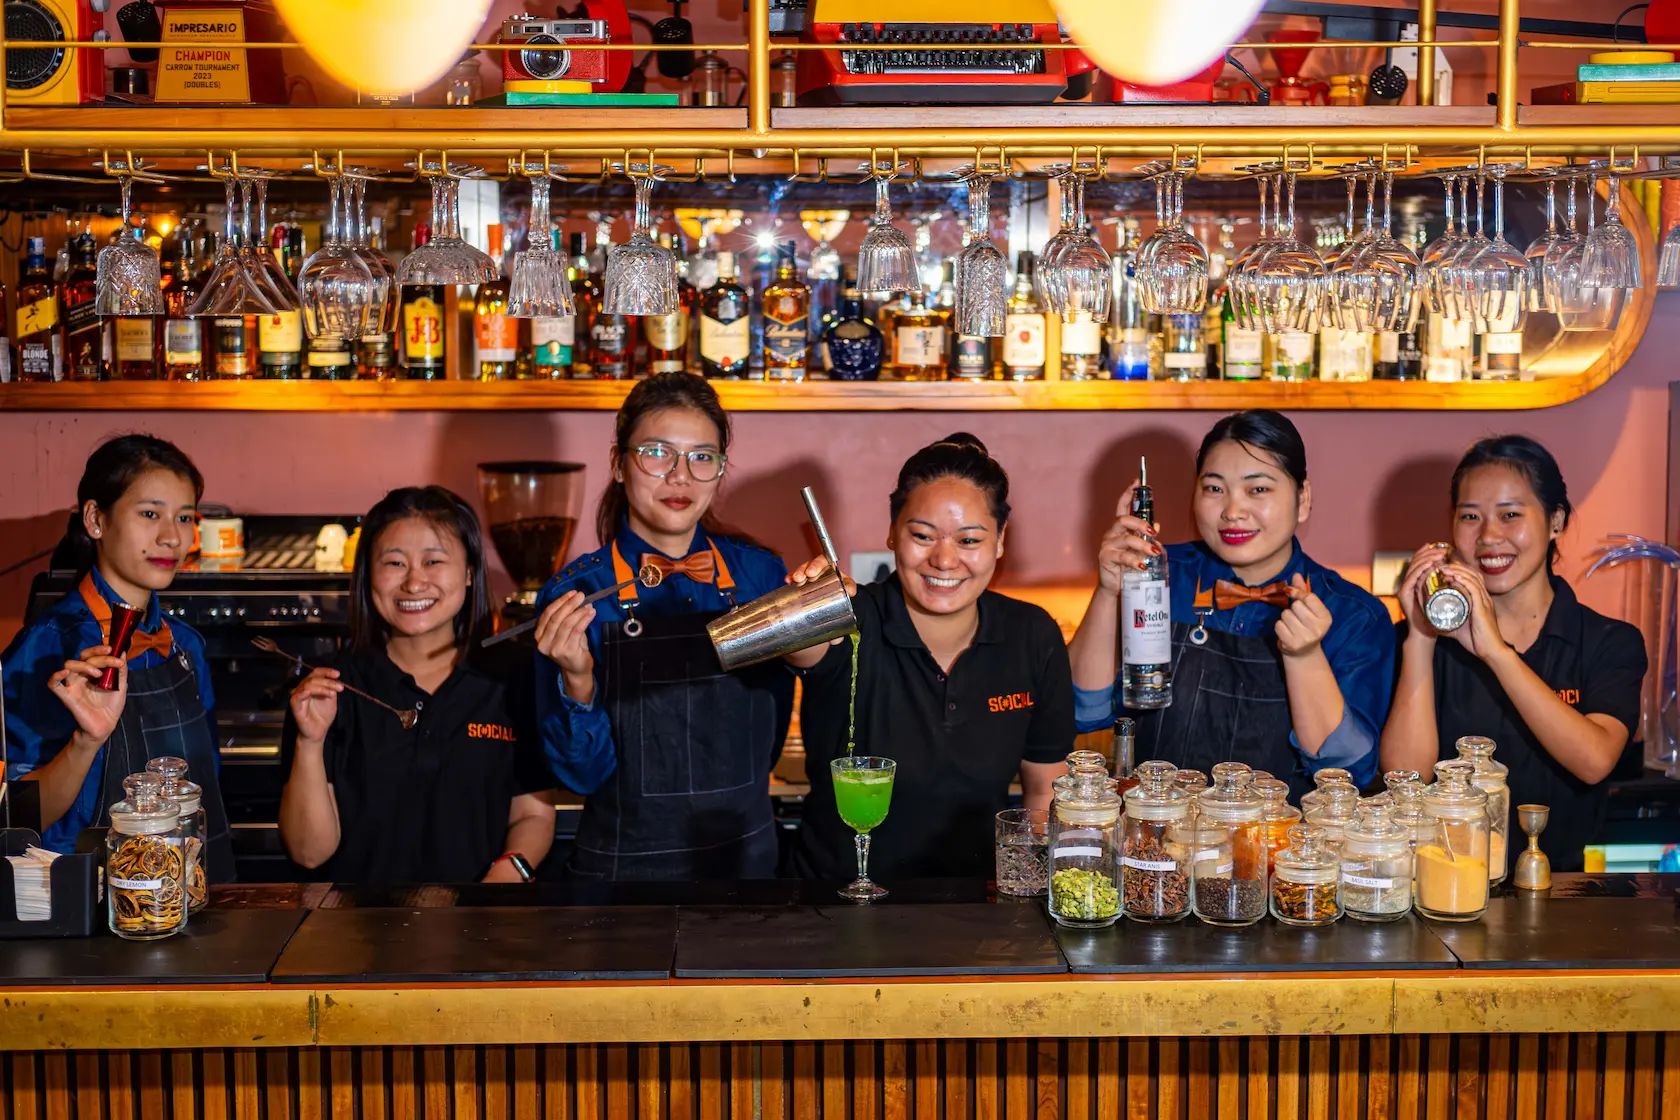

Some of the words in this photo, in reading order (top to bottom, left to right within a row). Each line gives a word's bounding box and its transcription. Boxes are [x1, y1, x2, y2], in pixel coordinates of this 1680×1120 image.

[175, 50, 231, 61] CHAMPION
[193, 72, 212, 80] 2023
[1134, 610, 1158, 627] Ketel
